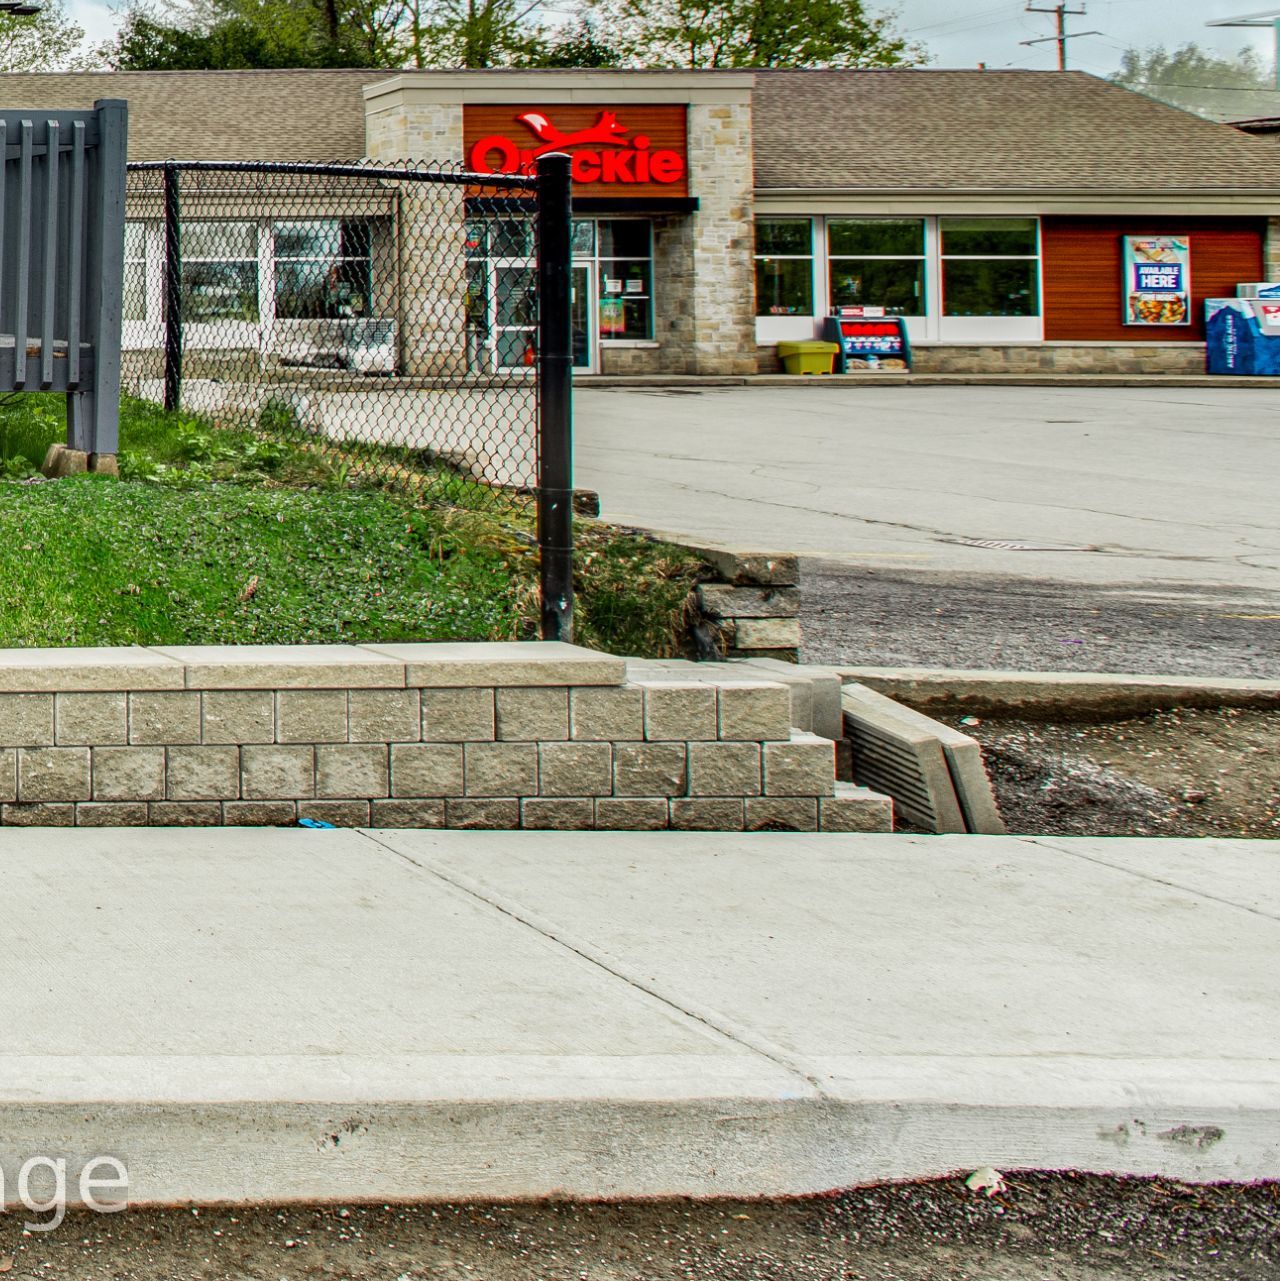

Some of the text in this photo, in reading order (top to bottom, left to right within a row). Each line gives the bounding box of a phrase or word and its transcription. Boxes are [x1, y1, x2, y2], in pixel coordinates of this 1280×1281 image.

[471, 133, 685, 183] Qckie
[1139, 266, 1180, 275] AVAILABLE
[1141, 274, 1177, 288] HERE
